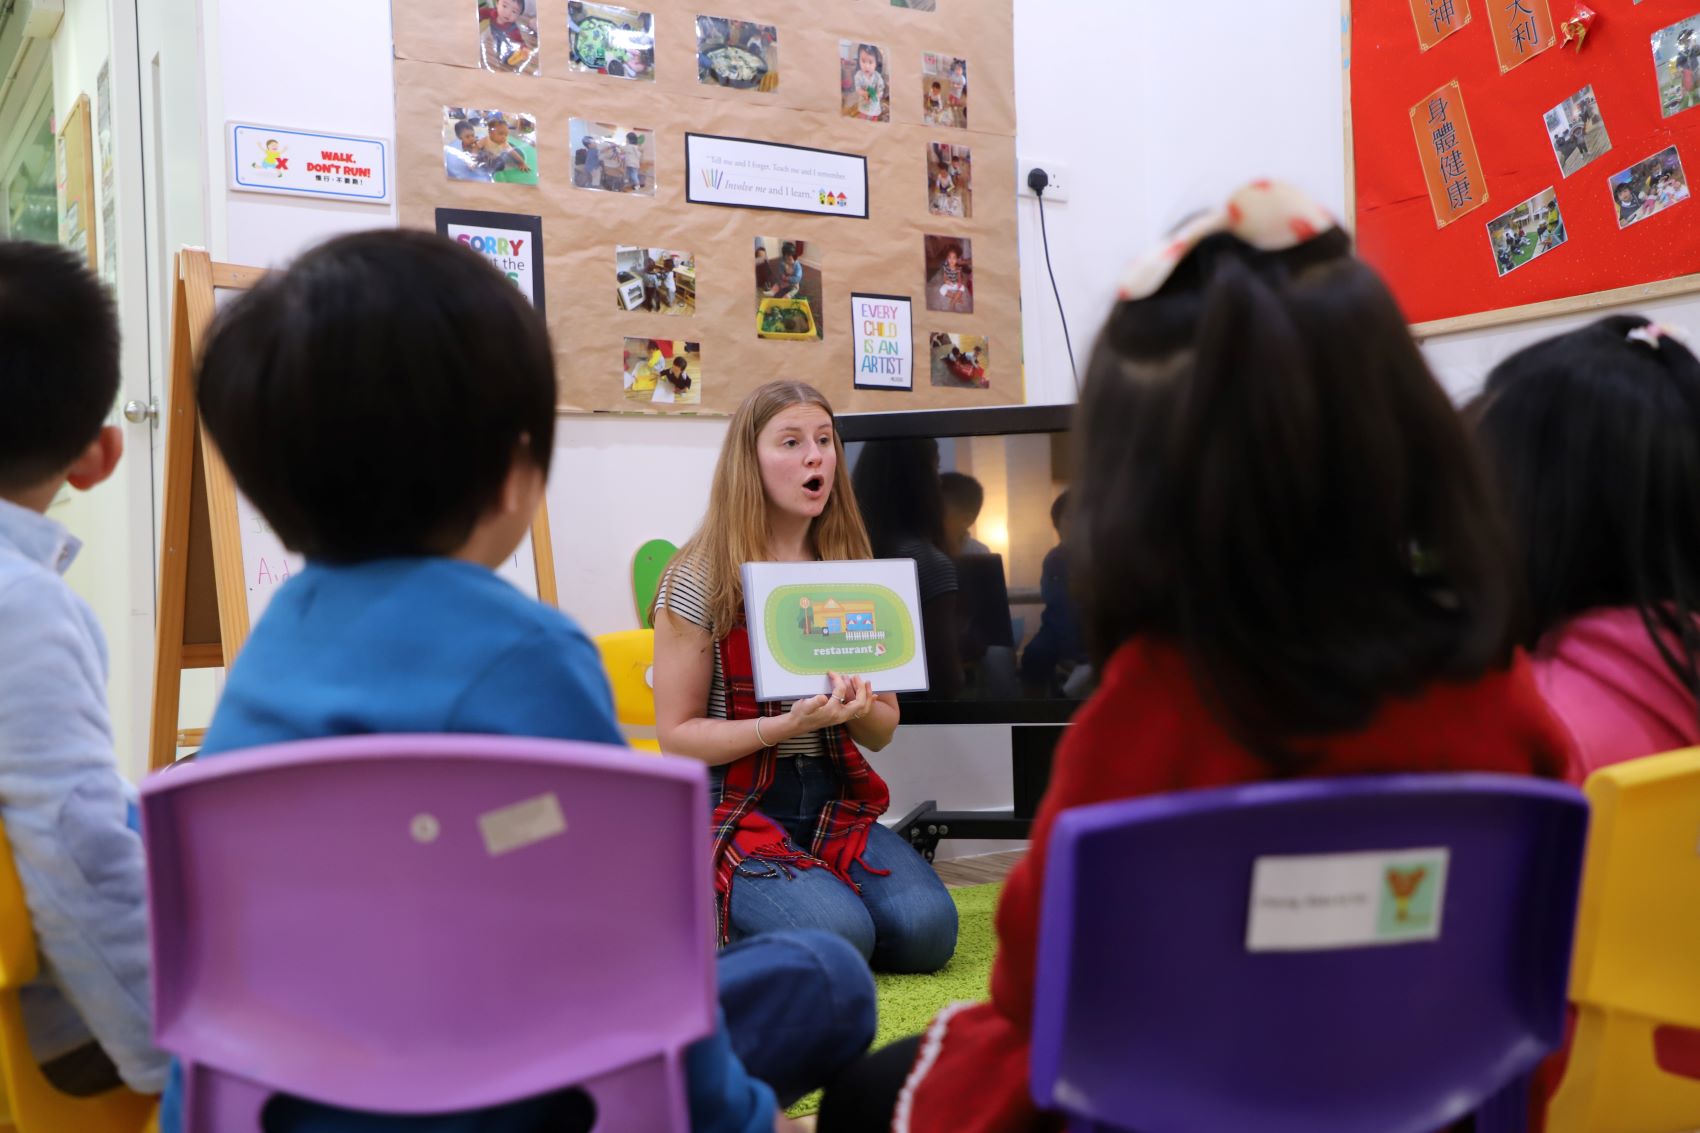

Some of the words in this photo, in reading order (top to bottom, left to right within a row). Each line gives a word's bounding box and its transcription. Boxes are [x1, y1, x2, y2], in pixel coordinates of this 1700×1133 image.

[1427, 0, 1458, 33] 神
[1428, 98, 1472, 209] 身體健康
[307, 162, 341, 174] DON'T
[343, 166, 371, 178] RUN!
[725, 180, 754, 192] Involve
[755, 185, 767, 193] me
[768, 186, 783, 196] and
[785, 186, 789, 196] I
[502, 257, 525, 271] the
[861, 303, 898, 320] EVERY
[864, 320, 897, 339] CHILD
[864, 339, 874, 354] IS
[878, 340, 899, 355] AN
[861, 354, 904, 375] ARTIST
[813, 645, 873, 656] restaurant
